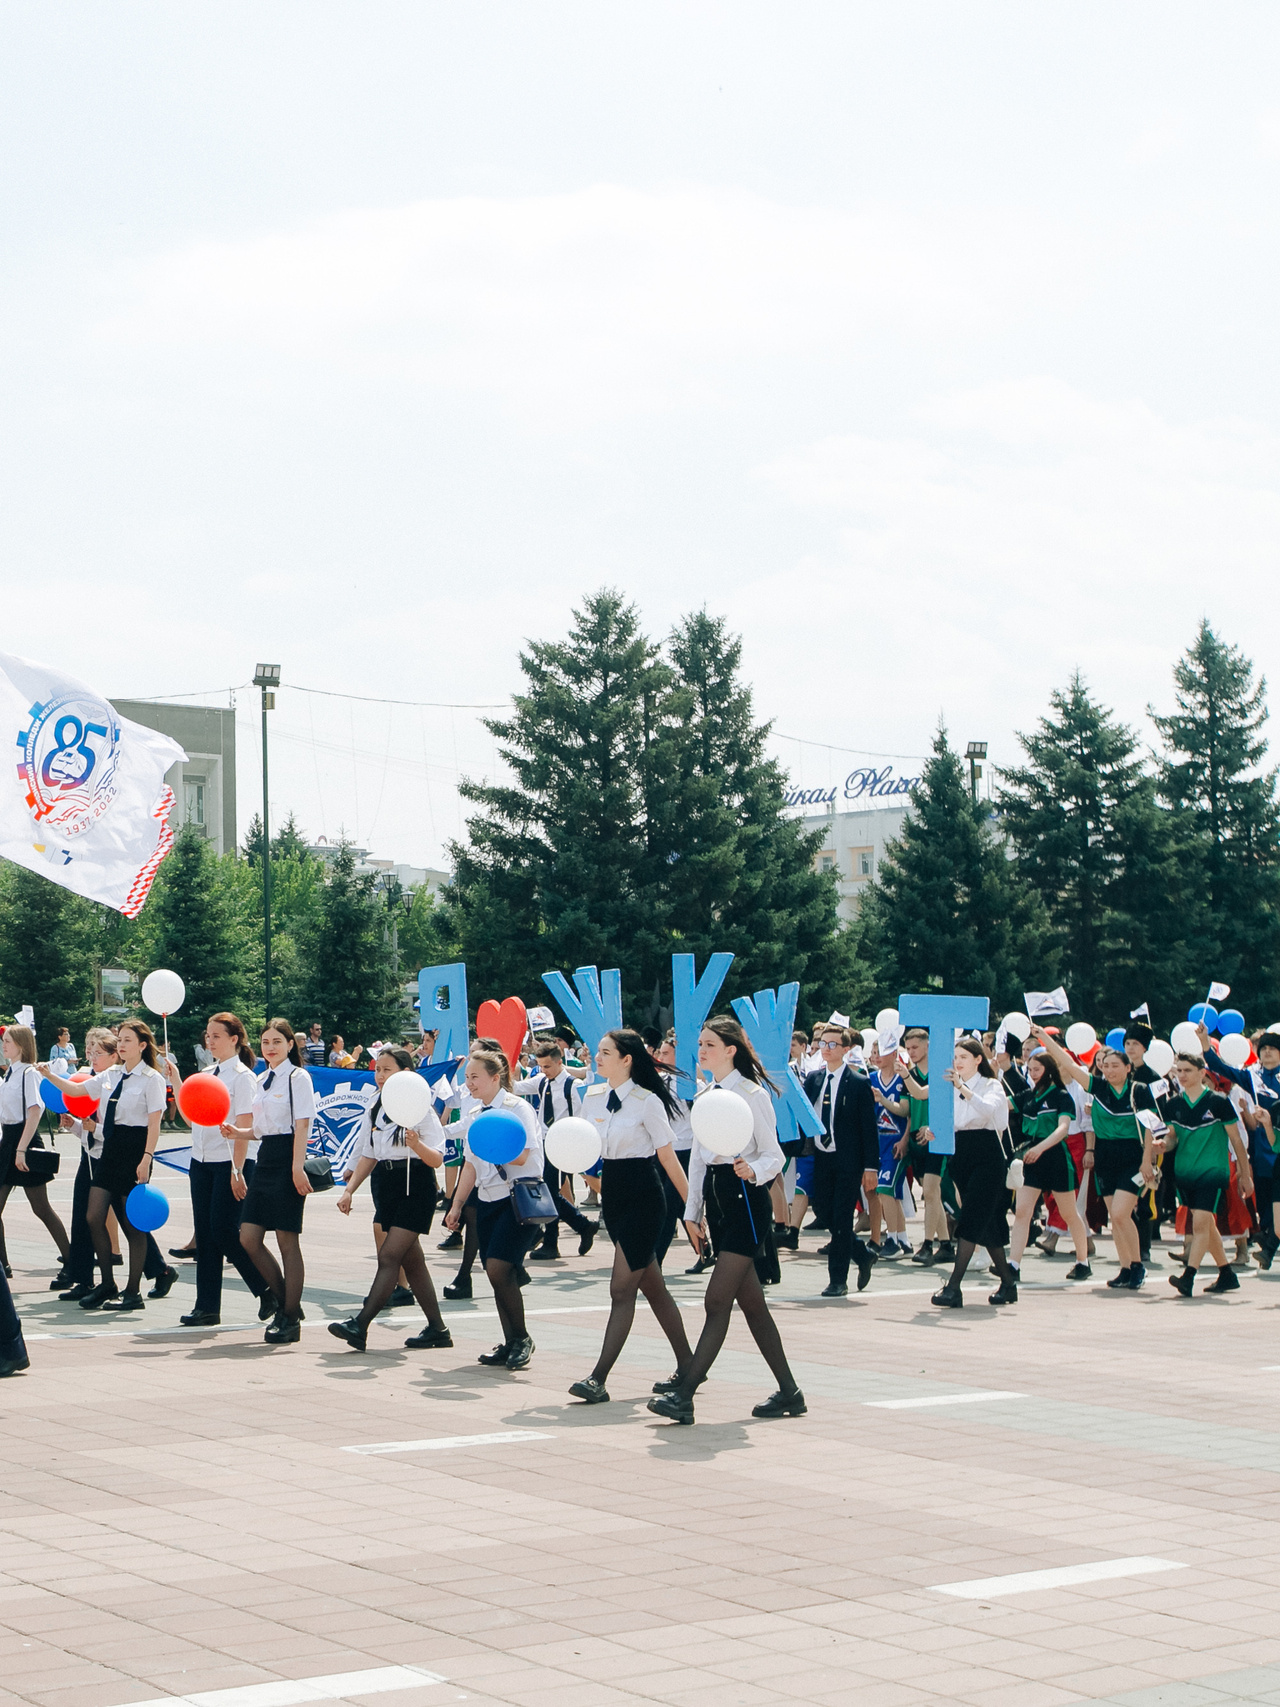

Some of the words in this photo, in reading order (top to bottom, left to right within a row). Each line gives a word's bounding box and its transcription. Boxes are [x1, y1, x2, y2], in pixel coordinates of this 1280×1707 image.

[26, 719, 43, 763] КОЛЛЕДЖ
[42, 714, 108, 790] 85
[65, 786, 118, 836] 1937-2022
[418, 963, 470, 1085] Я
